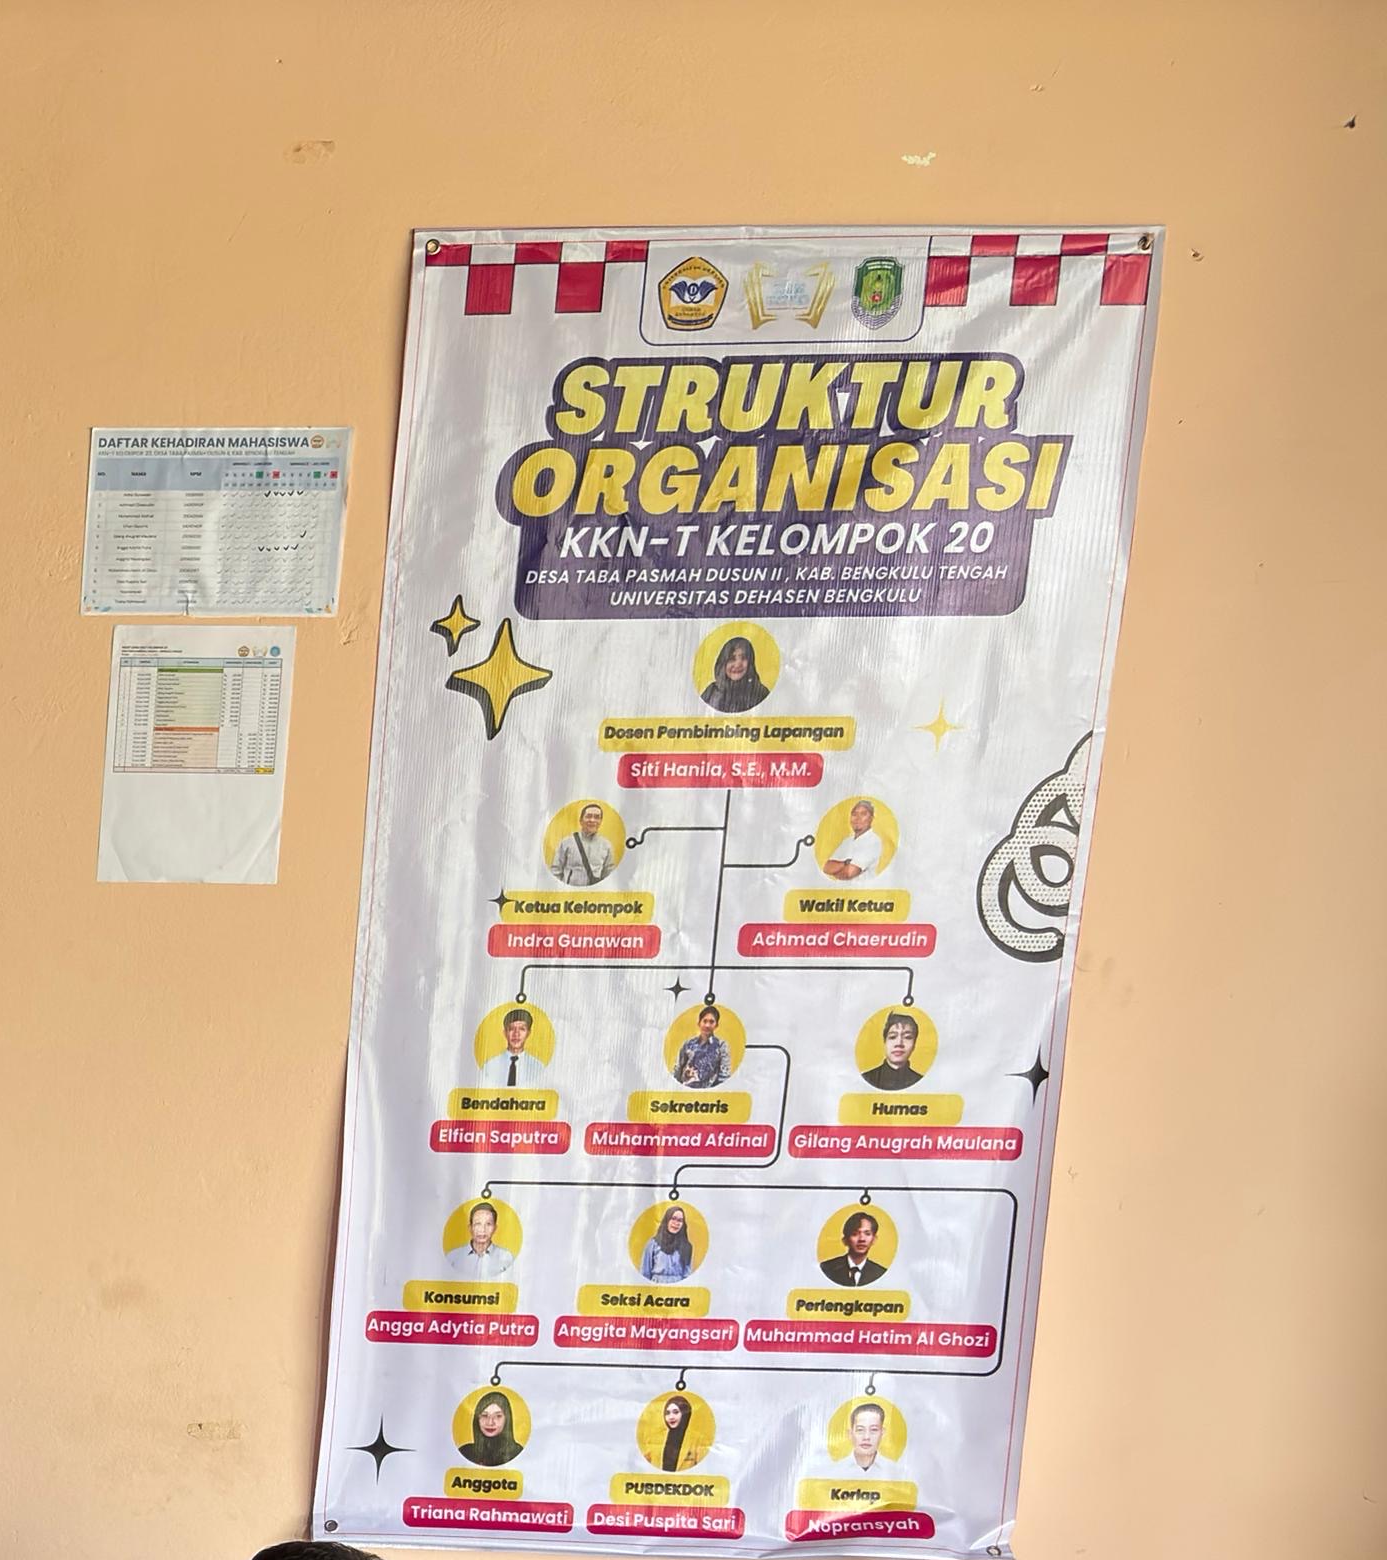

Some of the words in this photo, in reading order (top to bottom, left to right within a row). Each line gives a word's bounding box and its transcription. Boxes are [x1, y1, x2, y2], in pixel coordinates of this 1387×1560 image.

[555, 362, 1017, 436] STRUKTUR
[98, 437, 148, 448] DAFTAR
[151, 438, 224, 448] KEHADIRAN
[228, 437, 309, 448] MAHASISWA
[512, 441, 1063, 517] ORGANISASI
[559, 525, 703, 558] KKN-T
[705, 521, 936, 557] KELOMPOK
[943, 522, 994, 555] 20
[525, 569, 570, 585] DESA
[575, 568, 621, 584] TABA
[626, 568, 704, 584] PASMAH
[705, 567, 768, 583] DUSUN
[795, 566, 835, 582] KAB.
[841, 565, 933, 582] BENGKULU
[937, 564, 1008, 581] TENGAH
[609, 589, 729, 607] UNIVERSITAS
[734, 588, 822, 606] DEHASEN
[824, 587, 922, 604] BENGKULU
[604, 726, 654, 739] Dosen
[657, 724, 760, 741] Pembimbing
[763, 725, 844, 741] Lapangan
[631, 762, 660, 777] Siti
[663, 761, 726, 779] Hanila,
[731, 762, 765, 778] S.E.,
[770, 762, 812, 777] M.M.
[515, 901, 561, 915] Ketua
[564, 900, 643, 918] Kelompok
[799, 899, 844, 913] Wakil
[847, 899, 895, 913] Ketua
[508, 933, 553, 948] Indra
[558, 934, 644, 948] Gunawan
[752, 931, 829, 947] Achmad
[833, 931, 928, 948] Chaerudin
[461, 1097, 546, 1111] Bendahara
[650, 1100, 728, 1114] Sekretaris
[872, 1103, 928, 1116] Humas
[438, 1128, 486, 1144] Elfian
[490, 1129, 559, 1147] Saputra
[592, 1131, 701, 1147] Muhammad
[704, 1132, 768, 1148] Afdinal
[794, 1134, 852, 1152] Gilang
[855, 1135, 933, 1154] Anugrah
[936, 1135, 1017, 1151] Maulana
[424, 1291, 500, 1305] Konsumsi
[601, 1293, 641, 1307] Seksi
[643, 1294, 690, 1308] Acara
[795, 1299, 904, 1317] Perlengkapan
[368, 1318, 424, 1337] Angga
[427, 1319, 485, 1338] Adytia
[488, 1321, 535, 1337] Putra
[557, 1322, 627, 1343] Anggita
[630, 1324, 733, 1344] Mayangsari
[747, 1327, 854, 1343] Muhammad
[858, 1329, 913, 1346] Hatim
[916, 1331, 934, 1346] Al
[938, 1332, 990, 1348] Ghozi
[451, 1476, 518, 1493] Anggota
[625, 1482, 714, 1498] PUBDEKDOK
[831, 1488, 880, 1505] Korlap
[410, 1505, 465, 1521] Triana
[469, 1507, 568, 1526] Rahmawati
[593, 1513, 629, 1528] Desi
[633, 1514, 698, 1533] Puspita
[702, 1515, 736, 1531] Sari
[808, 1518, 920, 1537] Nopransyah
